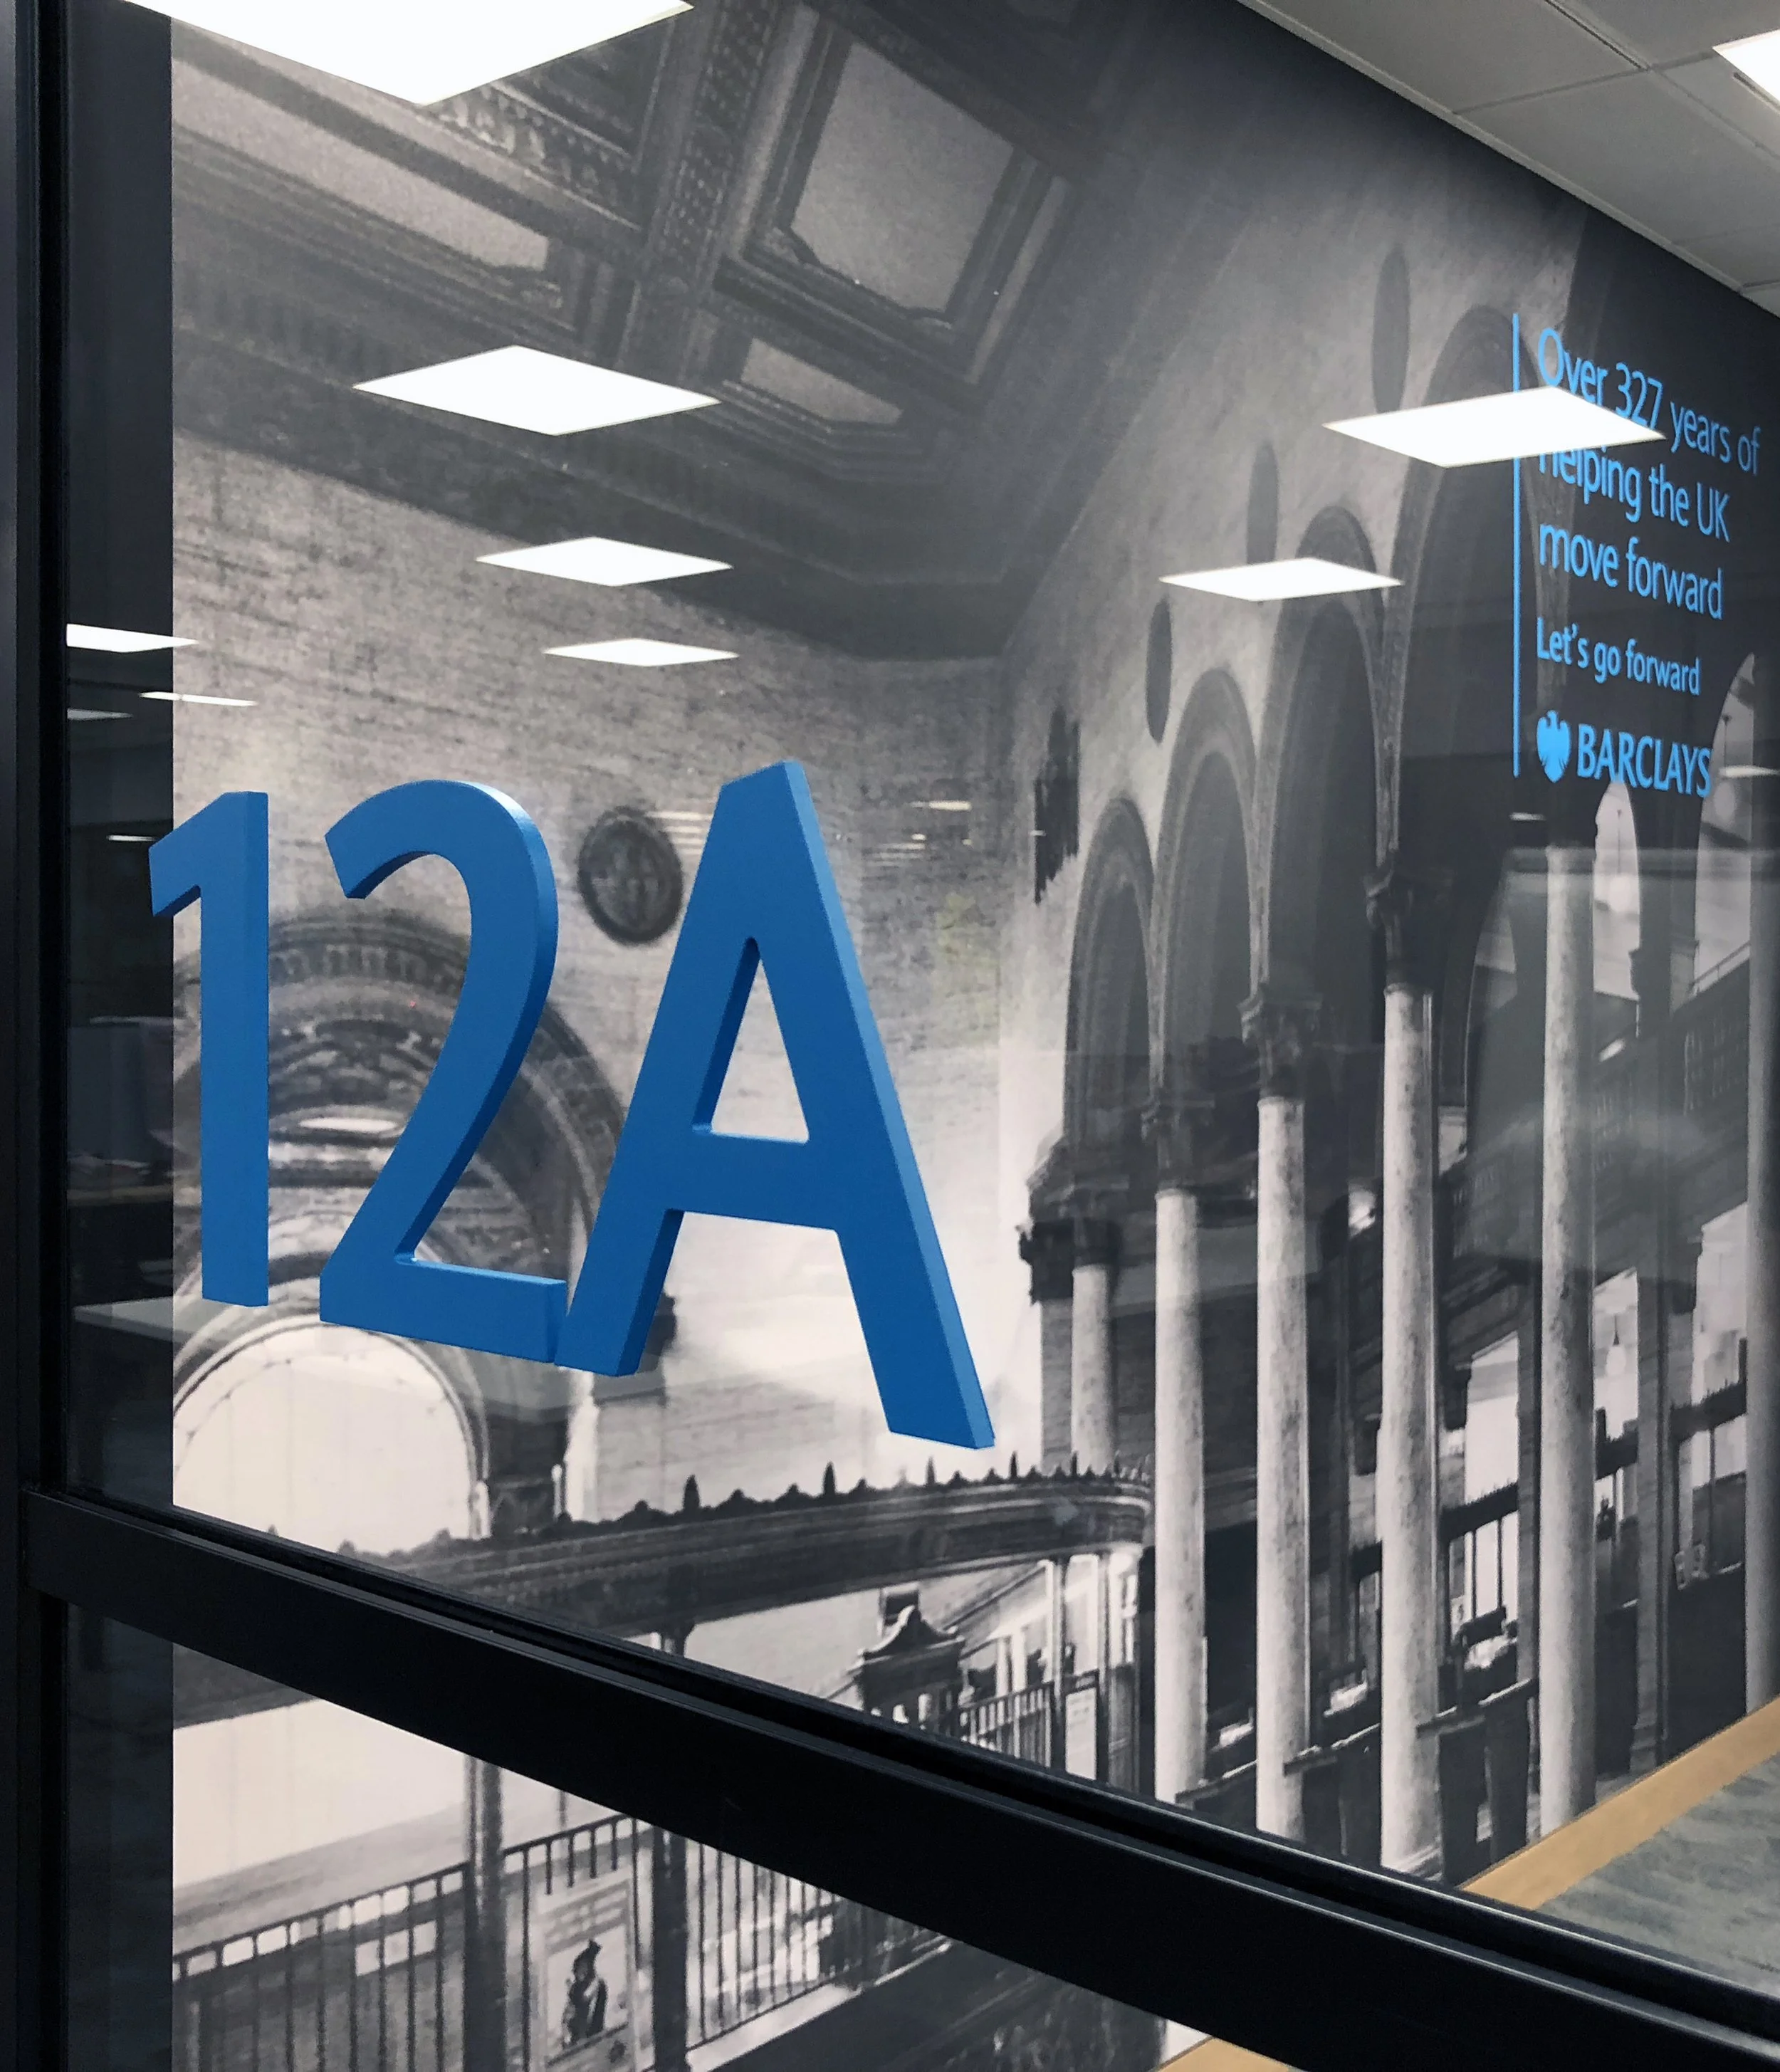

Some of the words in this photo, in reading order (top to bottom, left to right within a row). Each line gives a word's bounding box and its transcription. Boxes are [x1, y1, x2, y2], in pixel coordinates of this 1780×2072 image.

[1538, 327, 1608, 407] Over
[1615, 362, 1663, 429] 327
[1670, 400, 1732, 464] years
[1737, 426, 1761, 476] of
[1648, 463, 1690, 527] the
[1696, 482, 1730, 543] UK
[1539, 523, 1619, 588] move
[1625, 536, 1722, 620] forward
[1536, 616, 1588, 669] Let's
[1593, 642, 1621, 684] go
[1625, 639, 1700, 696] forward
[1576, 723, 1712, 798] BARCLAYS
[149, 760, 995, 1450] 12A
